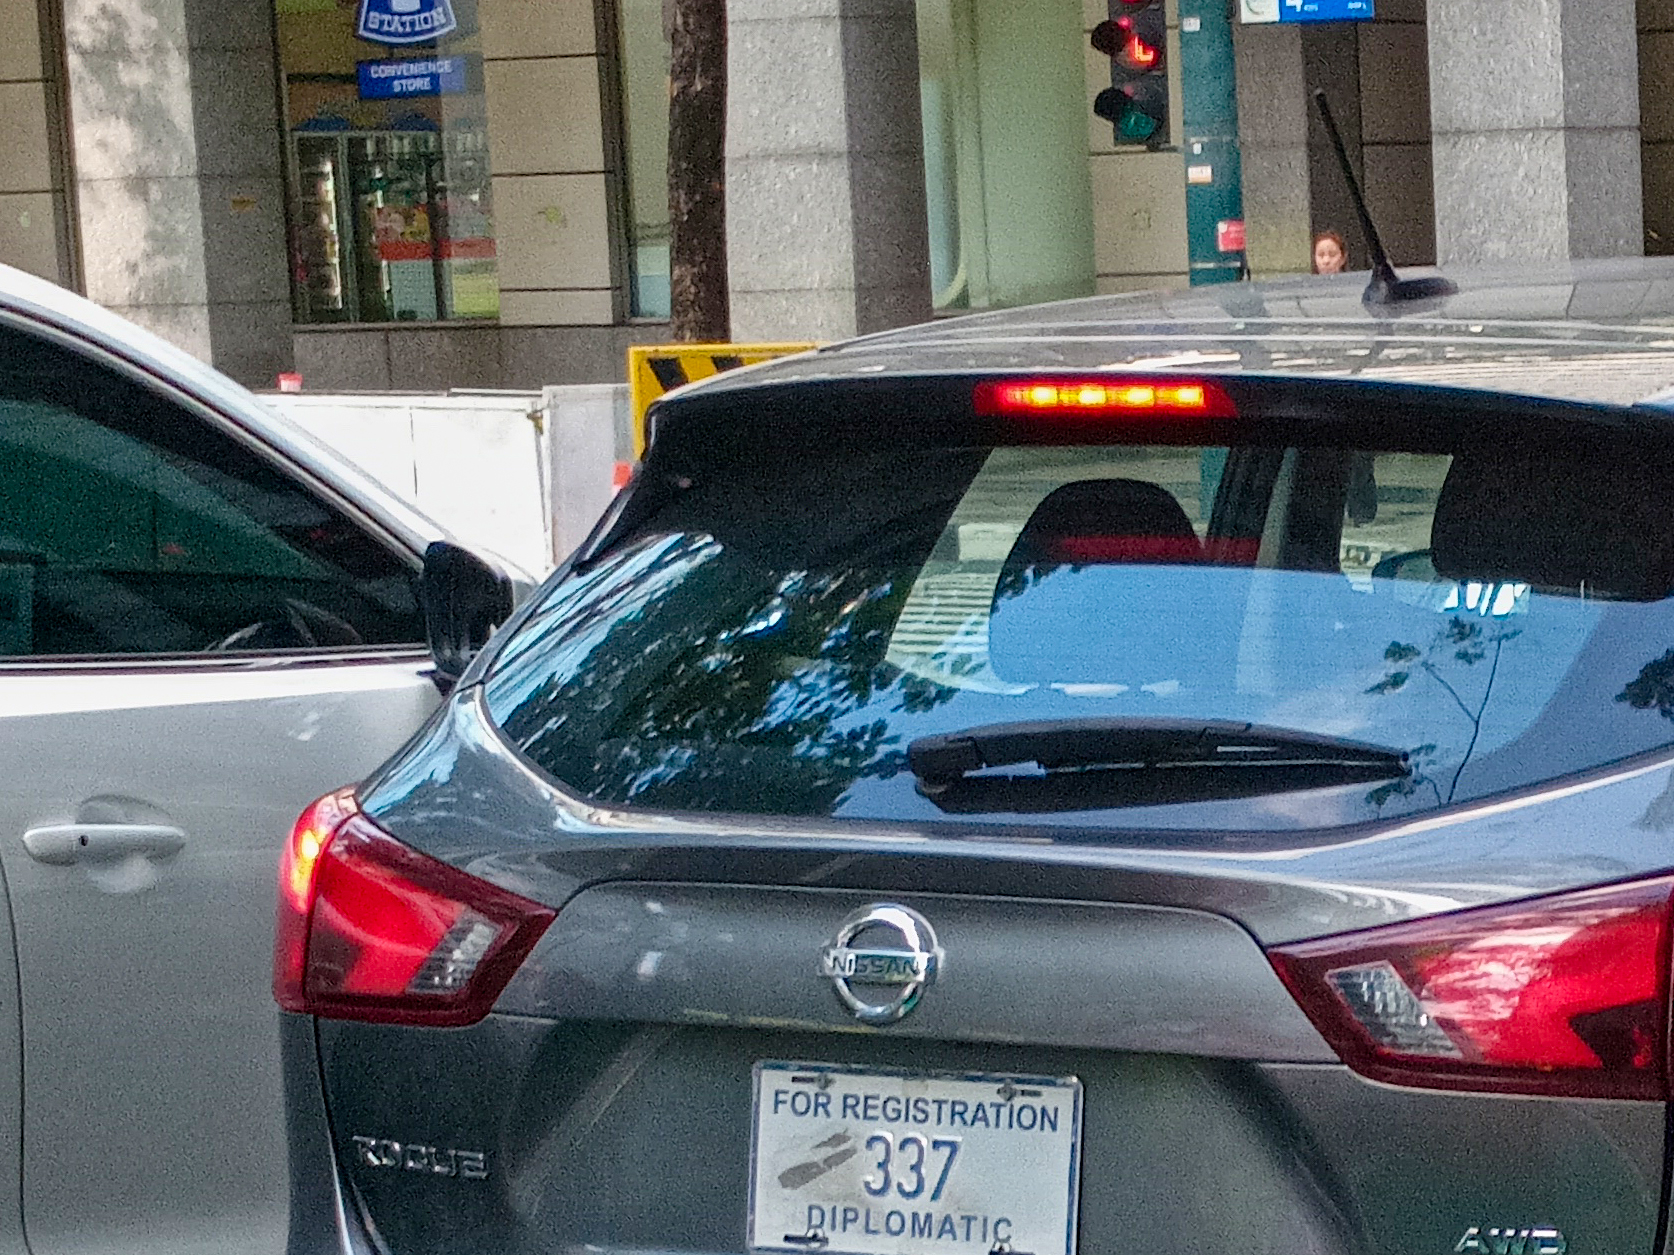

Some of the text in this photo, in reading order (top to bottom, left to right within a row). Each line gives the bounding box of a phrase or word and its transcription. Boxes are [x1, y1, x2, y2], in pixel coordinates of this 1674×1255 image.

[368, 7, 447, 33] STATION
[370, 60, 453, 77] CONVENIENCE
[393, 78, 431, 92] STORE
[830, 952, 920, 977] NISSAN
[773, 1089, 1060, 1132] FOR REGISTRATION
[352, 1135, 488, 1179] ROGUE
[863, 1133, 962, 1203] 337
[807, 1204, 1013, 1245] DIPLOMATIC
[1454, 1227, 1568, 1255] AWD
